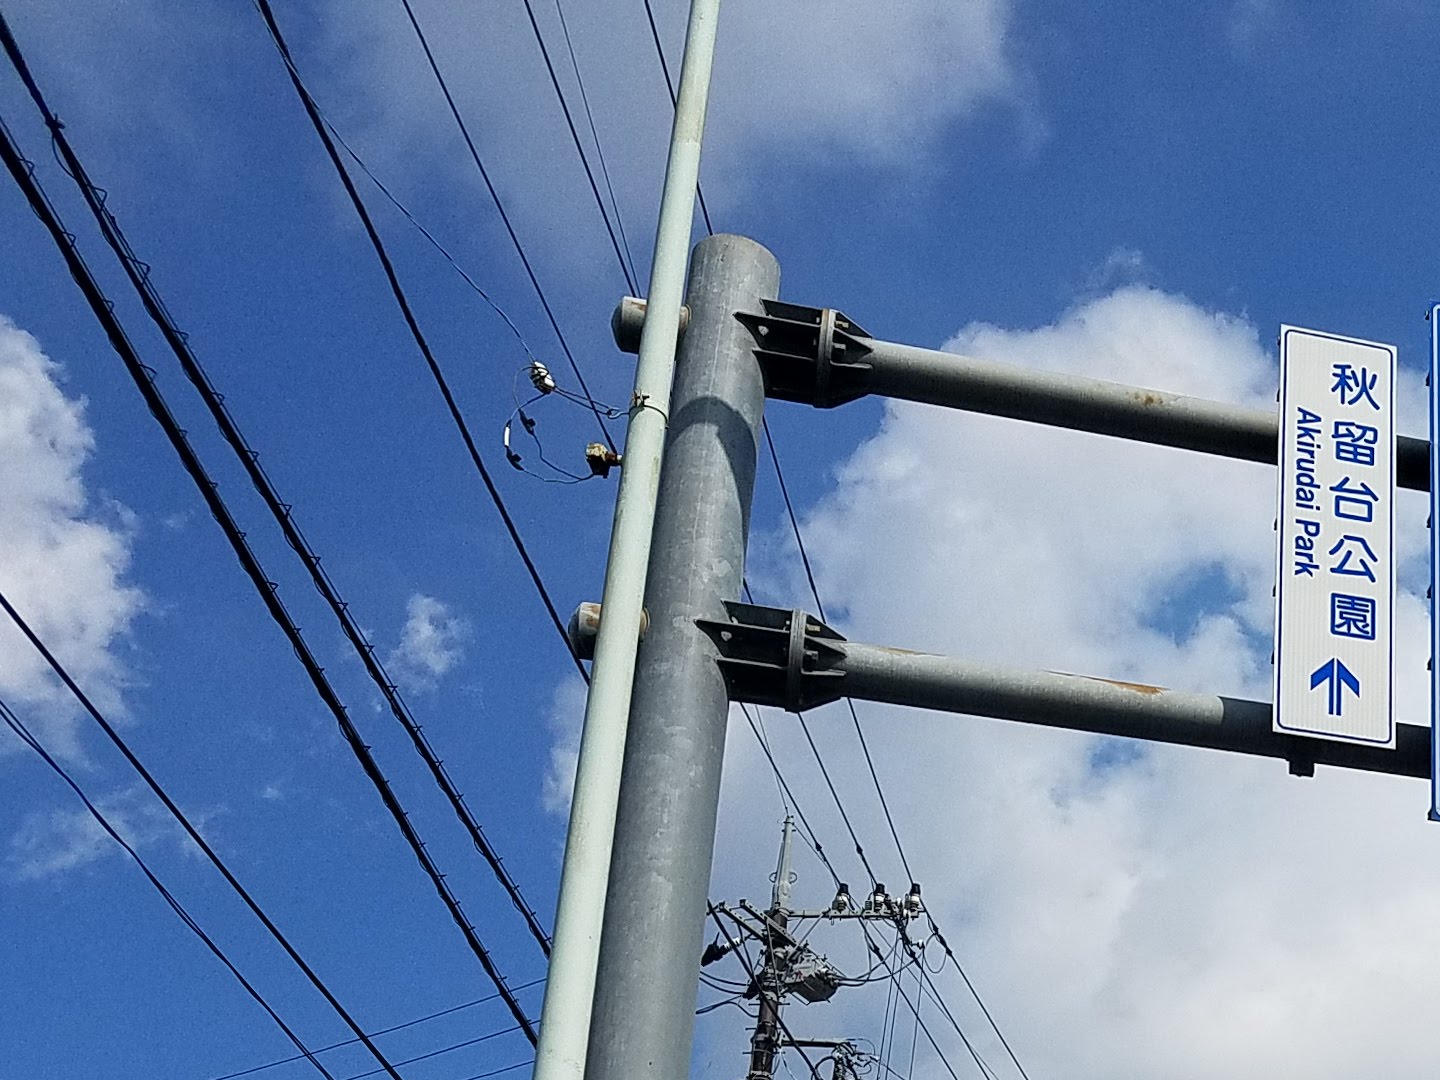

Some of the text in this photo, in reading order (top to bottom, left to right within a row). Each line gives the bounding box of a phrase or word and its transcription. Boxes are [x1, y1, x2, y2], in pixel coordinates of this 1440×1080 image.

[1293, 406, 1323, 578] Akirudai Park
[1328, 363, 1380, 642] 秋留台公園
